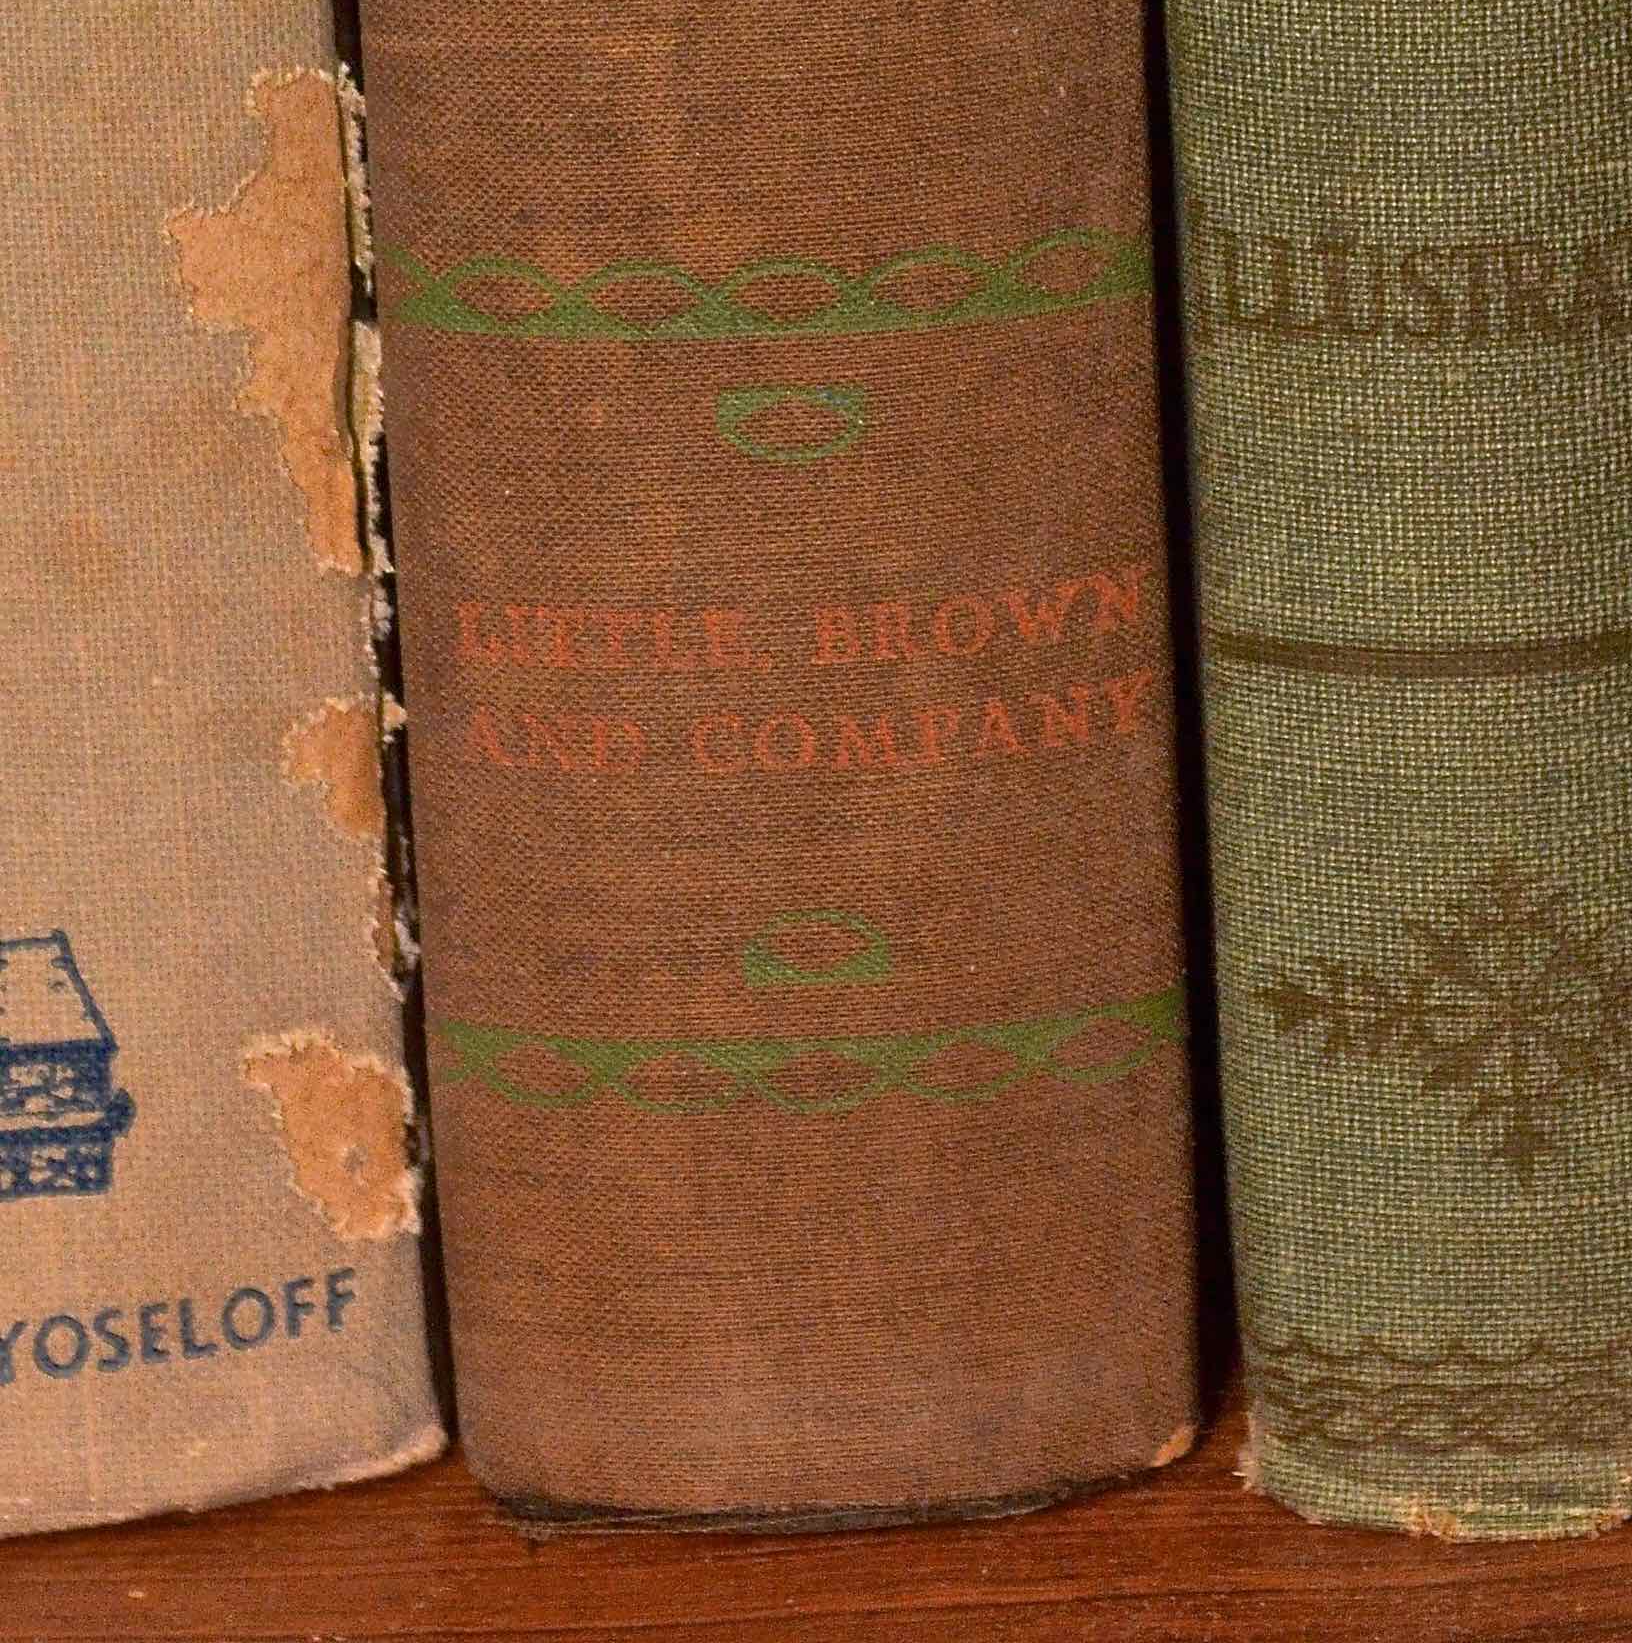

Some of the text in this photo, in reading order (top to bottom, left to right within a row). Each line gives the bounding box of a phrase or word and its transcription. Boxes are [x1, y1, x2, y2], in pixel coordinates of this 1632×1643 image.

[810, 563, 1154, 665] BROWN
[468, 668, 1154, 773] AND COMPANY
